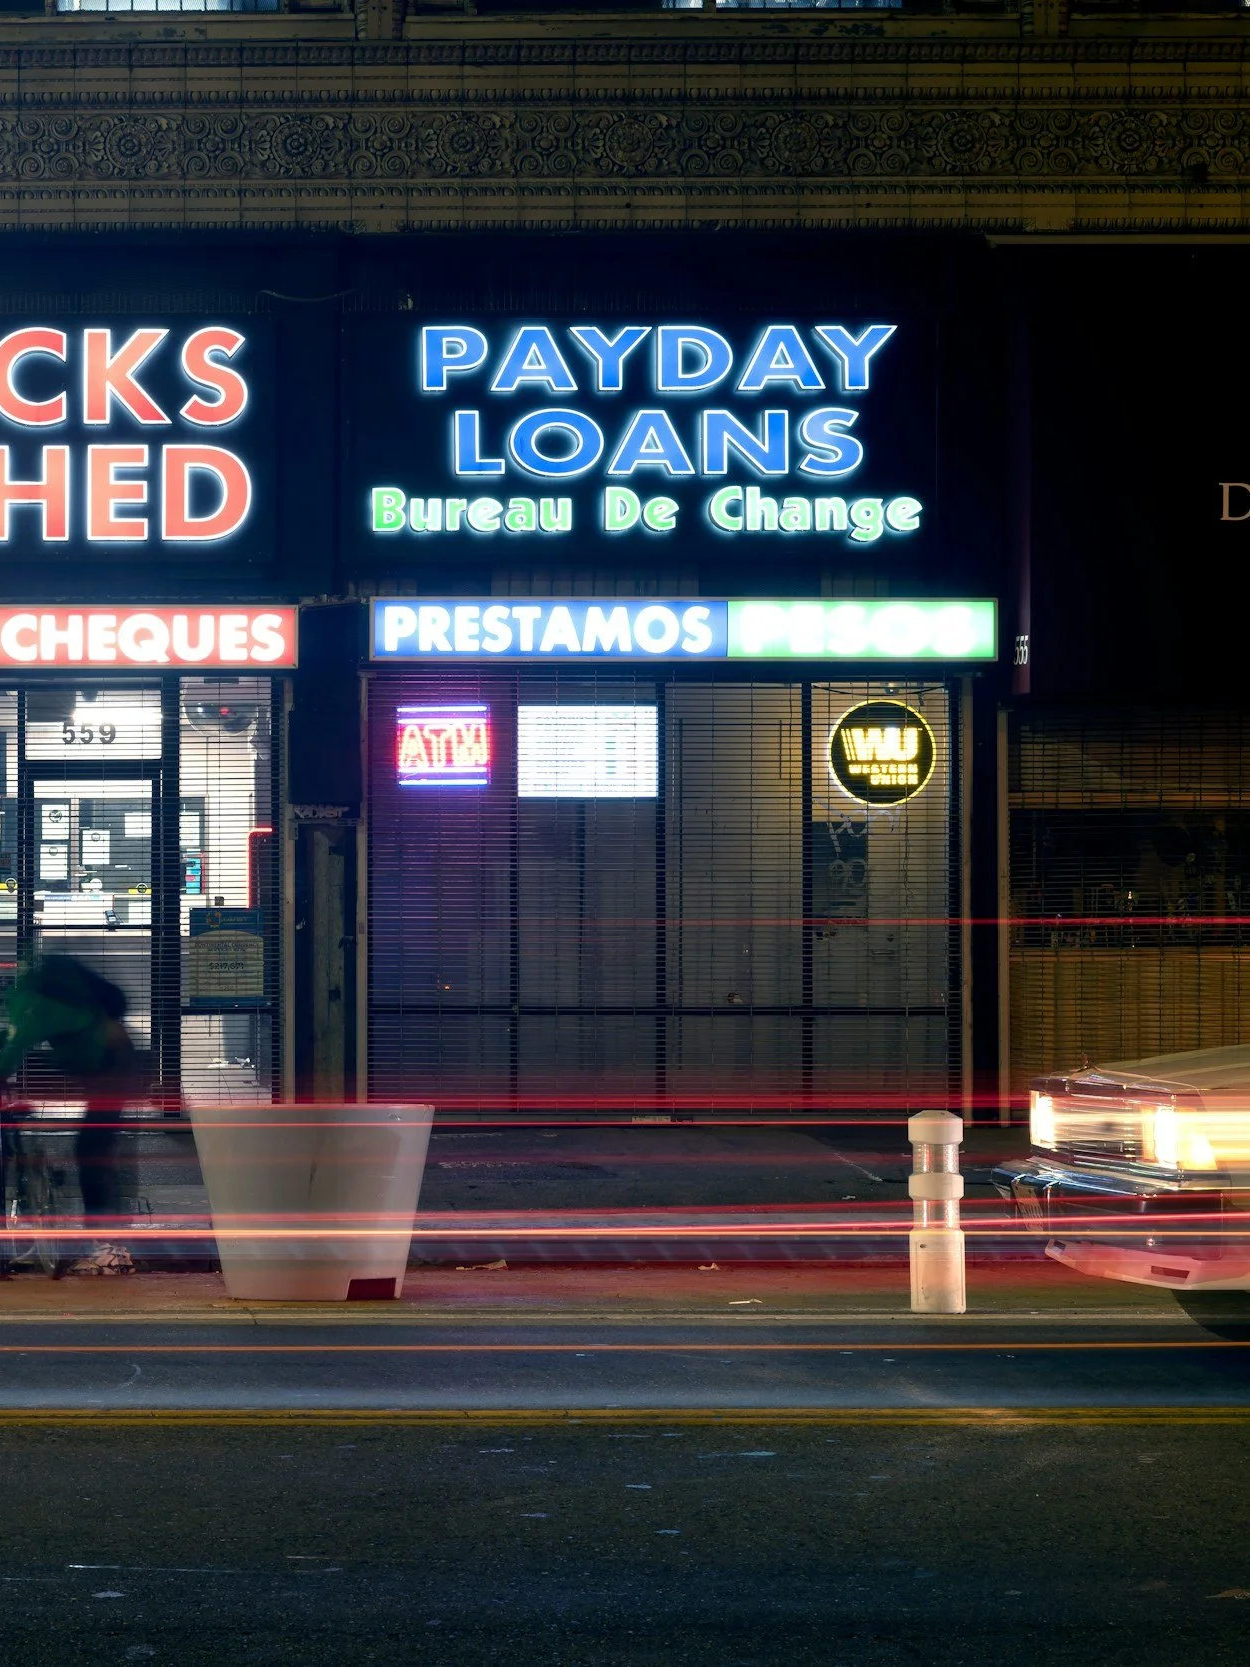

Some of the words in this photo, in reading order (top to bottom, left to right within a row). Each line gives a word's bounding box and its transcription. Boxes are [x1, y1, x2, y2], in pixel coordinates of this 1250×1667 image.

[419, 323, 899, 393] PAYDAY
[452, 407, 865, 477] LOANS
[370, 486, 574, 533] Bureau
[605, 486, 680, 531] De
[709, 485, 924, 543] Change
[1, 612, 285, 663] CHEQUES
[383, 605, 713, 653] PRESTAMOS
[61, 721, 117, 745] 559
[399, 723, 488, 768] ATM
[848, 764, 919, 774] WESTERN
[870, 774, 919, 785] UNION
